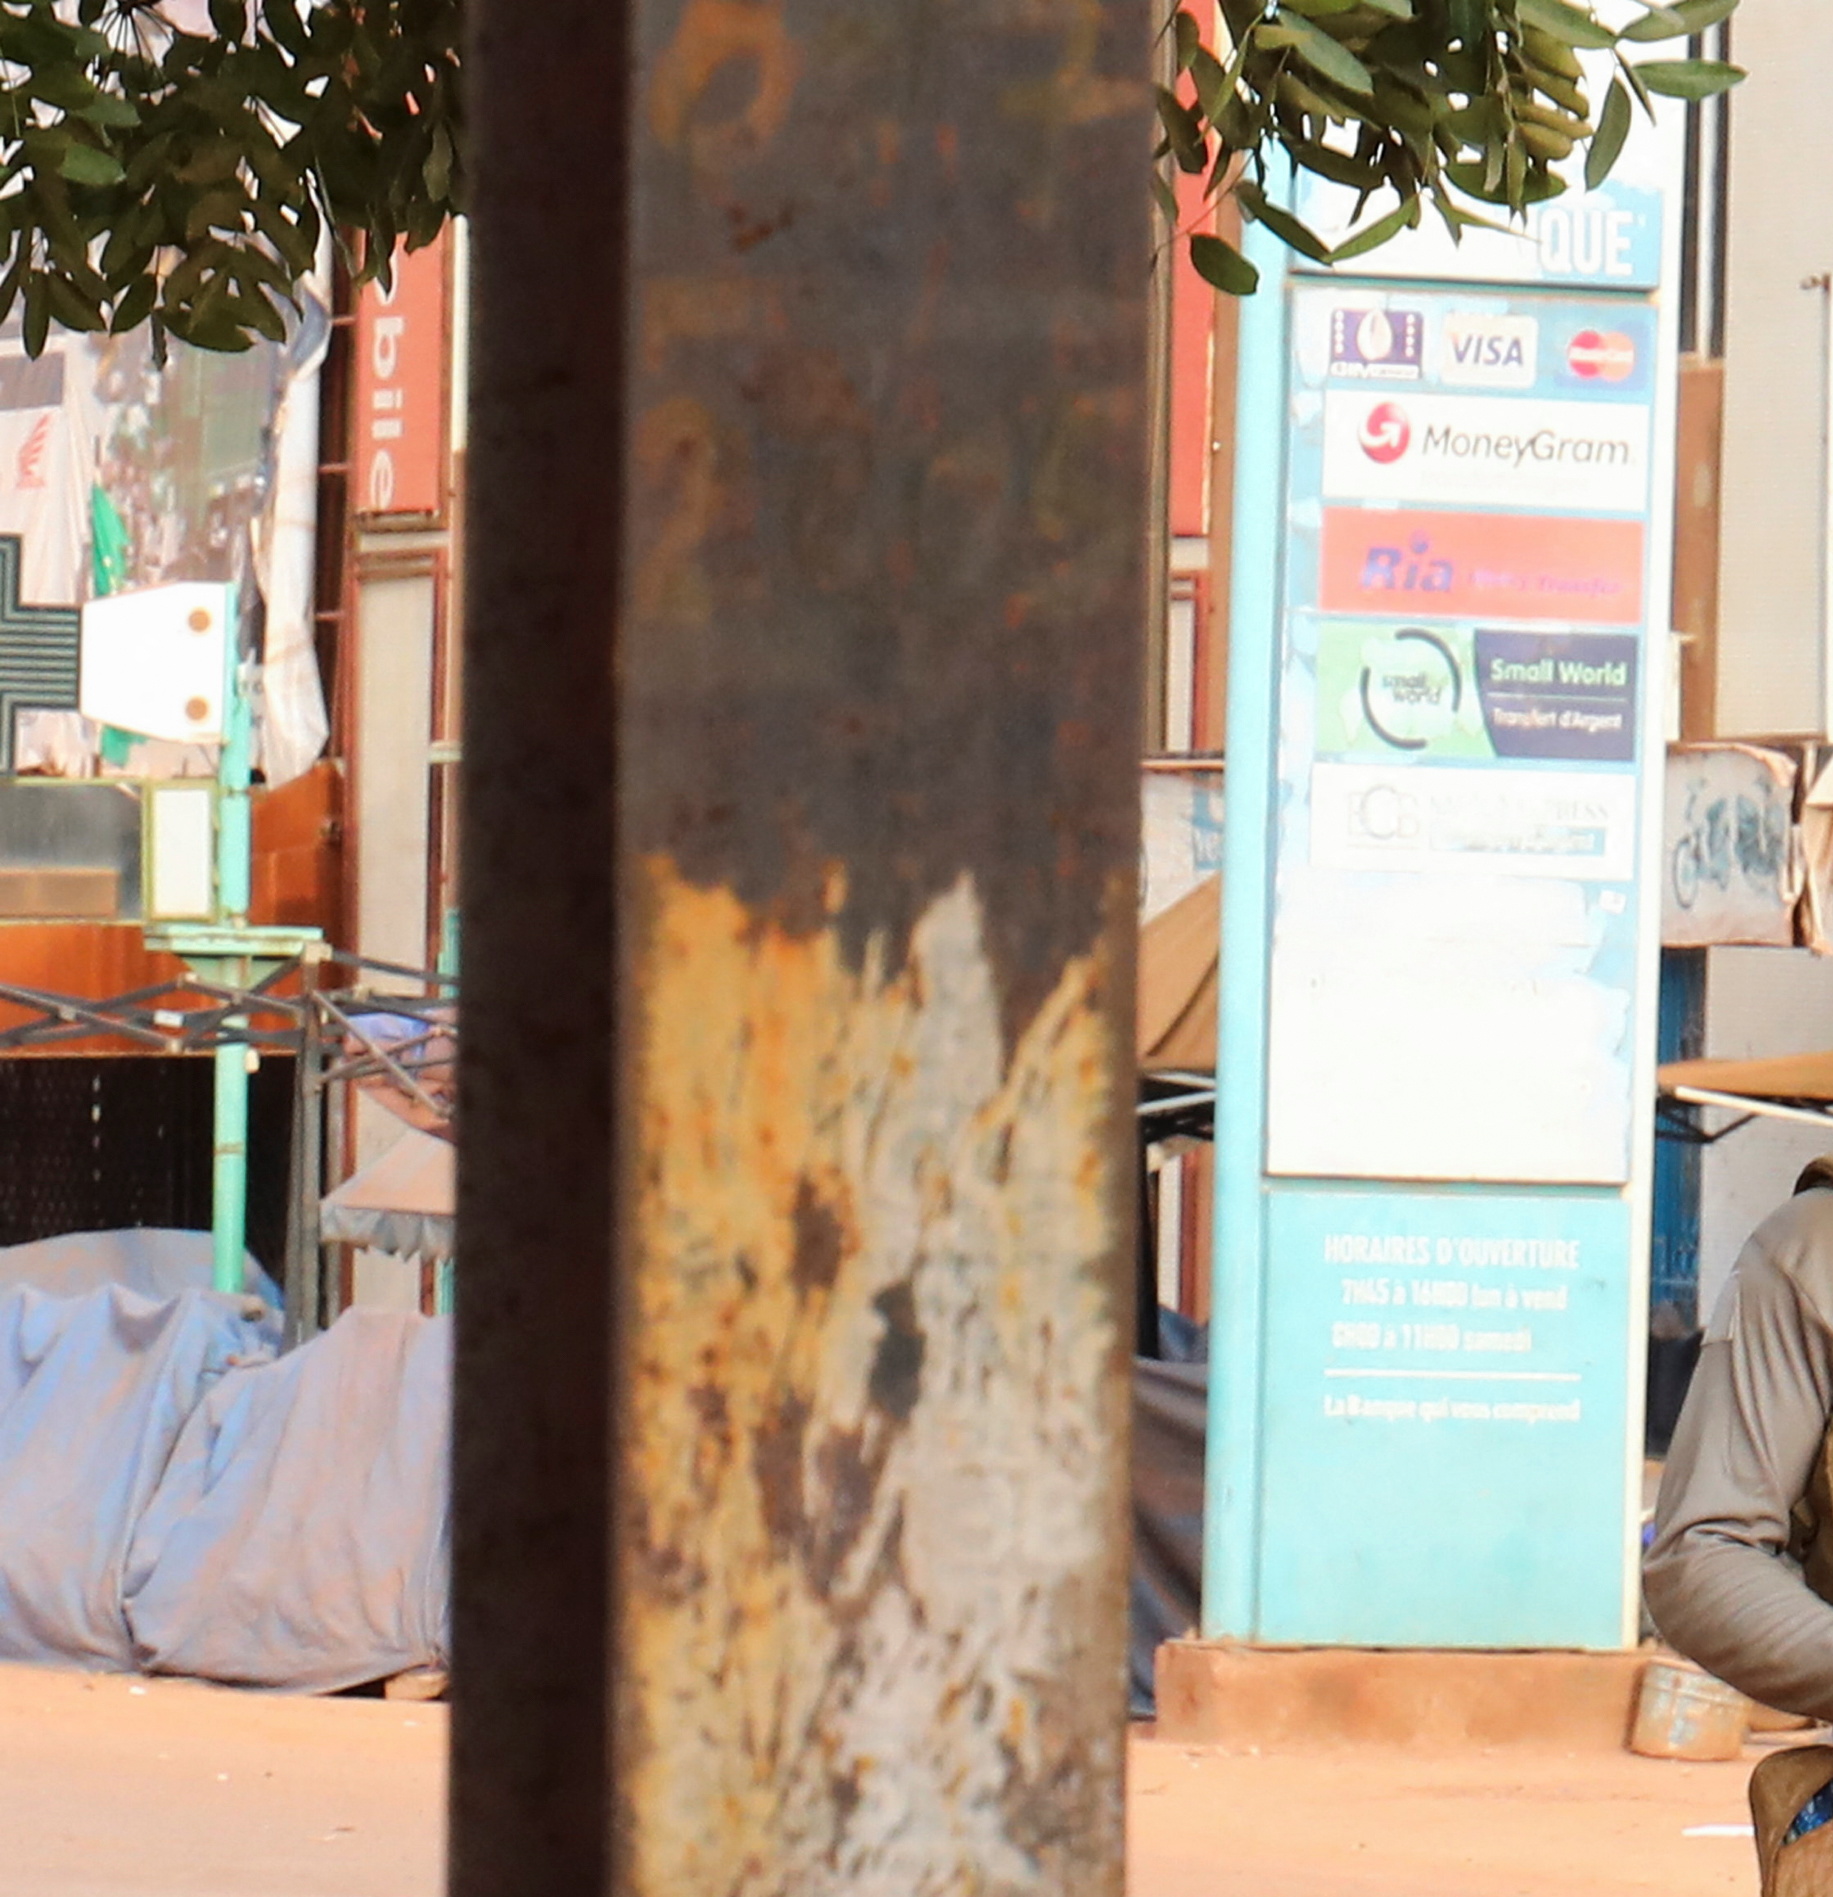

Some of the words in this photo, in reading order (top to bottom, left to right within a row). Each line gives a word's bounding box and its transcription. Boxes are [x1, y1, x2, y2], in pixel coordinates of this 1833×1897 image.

[1453, 333, 1523, 367] VISA
[1422, 425, 1631, 467] MoneyGram
[1360, 528, 1454, 592] Ria
[1490, 660, 1551, 683] Small
[1557, 662, 1627, 686] World
[1391, 687, 1440, 705] world
[1493, 707, 1557, 728] Transfert
[1324, 1234, 1430, 1265] HORAIRES
[1436, 1237, 1580, 1269] D'OUVERTURE
